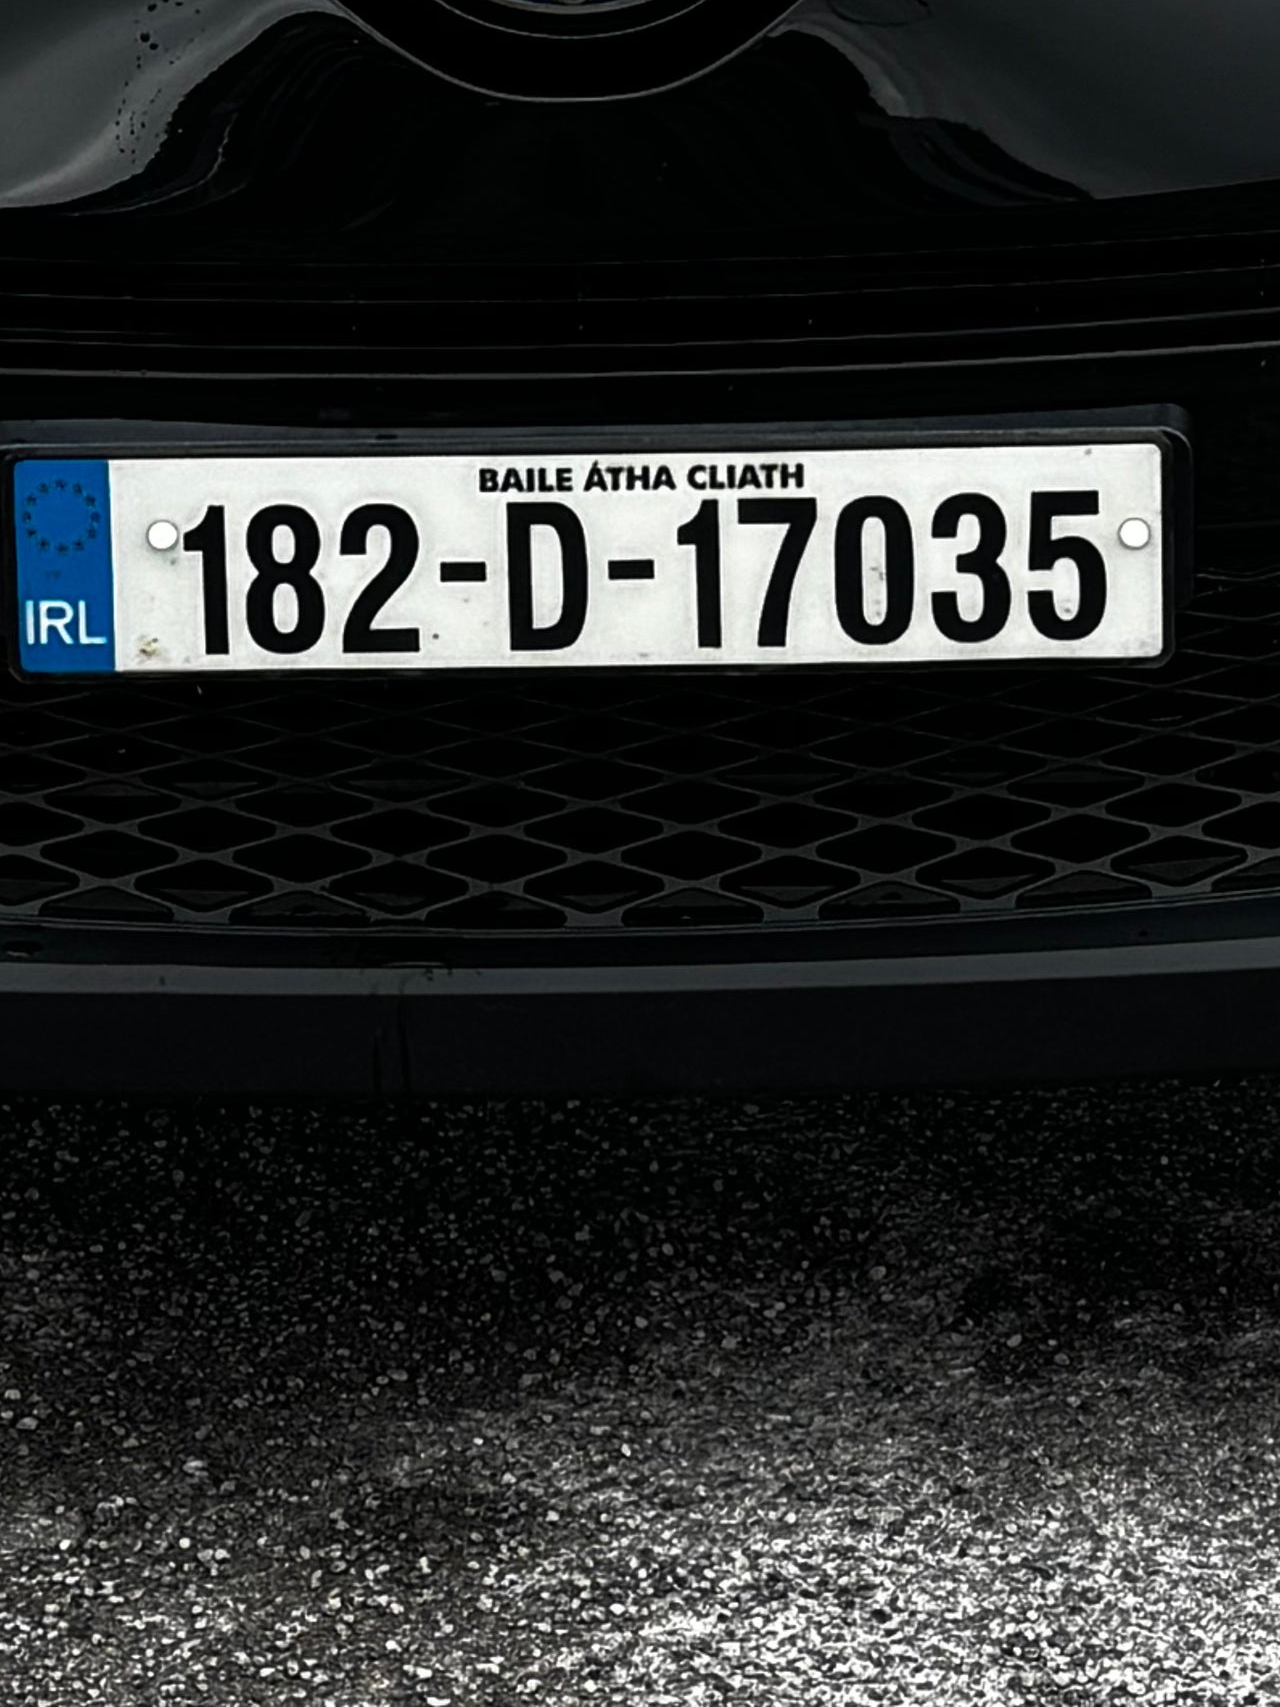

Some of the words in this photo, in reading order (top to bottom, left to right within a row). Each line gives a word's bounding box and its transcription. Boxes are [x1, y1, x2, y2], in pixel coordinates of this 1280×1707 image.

[478, 467, 574, 493] BAILE
[582, 459, 678, 492] ÁTHA
[686, 462, 806, 491] CLIATH
[182, 490, 1108, 656] 182-D-17035
[24, 599, 109, 646] IRL
